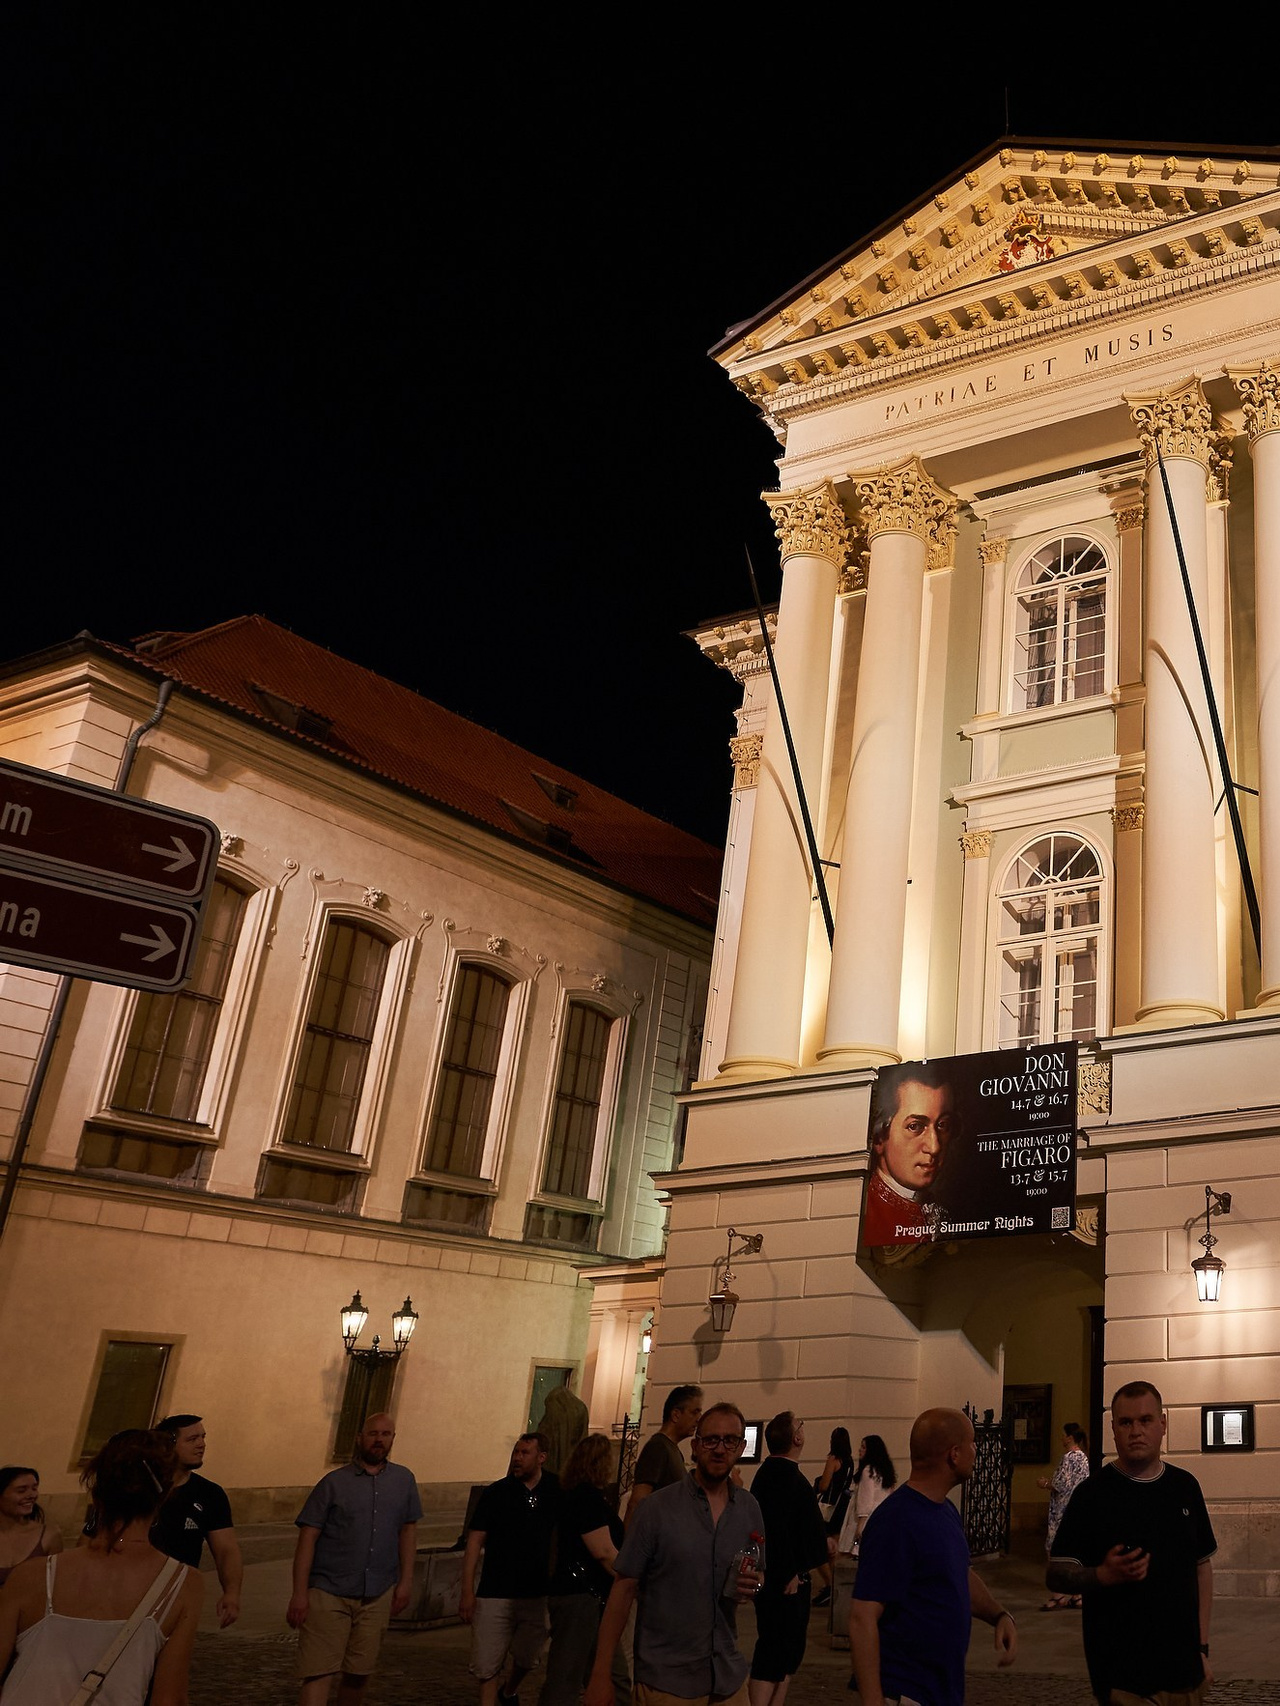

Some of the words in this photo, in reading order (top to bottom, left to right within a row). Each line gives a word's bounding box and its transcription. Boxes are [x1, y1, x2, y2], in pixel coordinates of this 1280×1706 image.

[884, 374, 997, 423] PATRIAE
[1023, 356, 1058, 382] ET
[1084, 323, 1174, 364] MUSIS
[1025, 1052, 1066, 1074] DON
[980, 1069, 1070, 1098] GIOVANNI
[1011, 1098, 1031, 1111] 14.7
[1033, 1094, 1046, 1106] &
[1048, 1093, 1069, 1106] 16.7
[977, 1140, 999, 1152] THE
[1000, 1134, 1055, 1150] MARRIAGE
[1057, 1132, 1072, 1145] OF
[1000, 1145, 1071, 1169] FIGARO
[1010, 1173, 1031, 1185] 13.7
[1033, 1169, 1046, 1182] &
[1048, 1169, 1068, 1182] 15.7
[894, 1223, 937, 1238] Prague
[940, 1220, 990, 1234] Summer
[994, 1215, 1034, 1230] Nights
